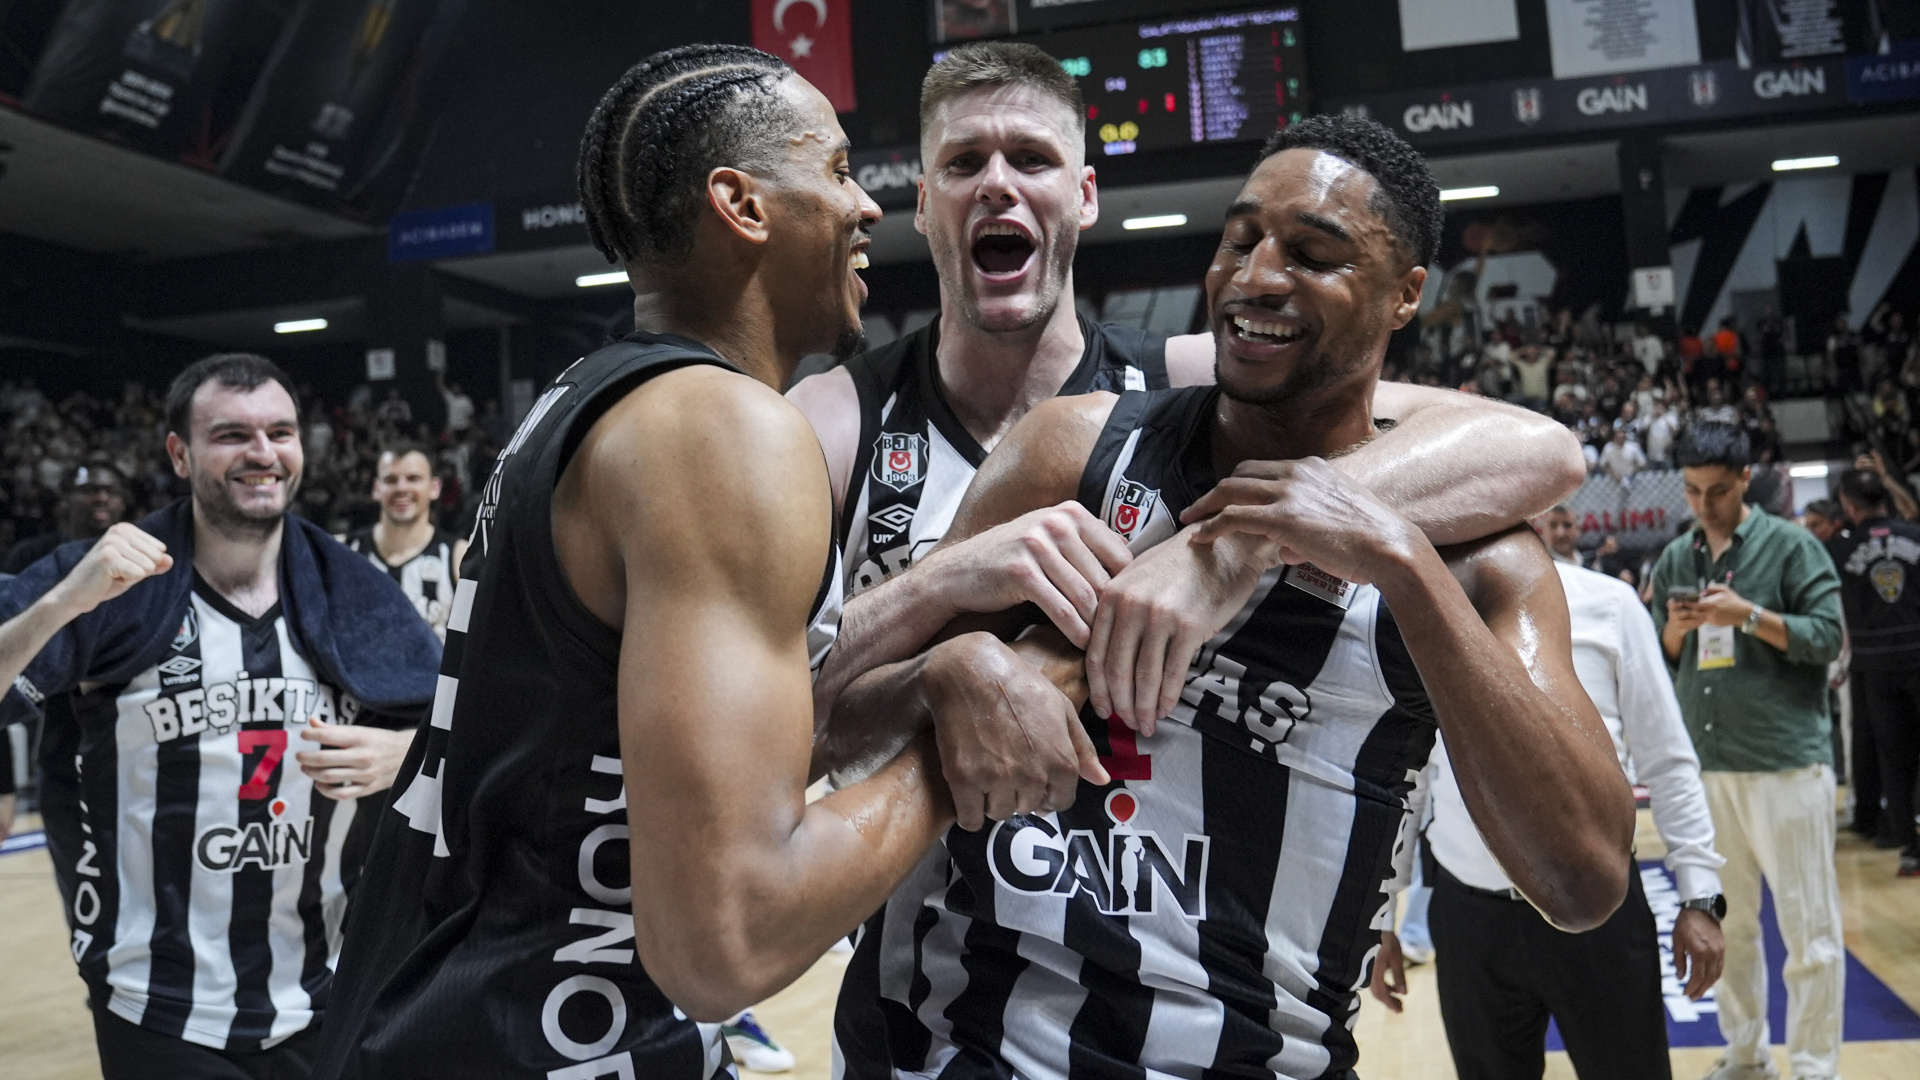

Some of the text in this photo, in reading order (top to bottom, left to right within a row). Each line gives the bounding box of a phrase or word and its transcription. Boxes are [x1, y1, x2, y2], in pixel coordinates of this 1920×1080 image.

[885, 471, 917, 483] 1903
[162, 673, 200, 686] umbro
[236, 729, 288, 801] 7
